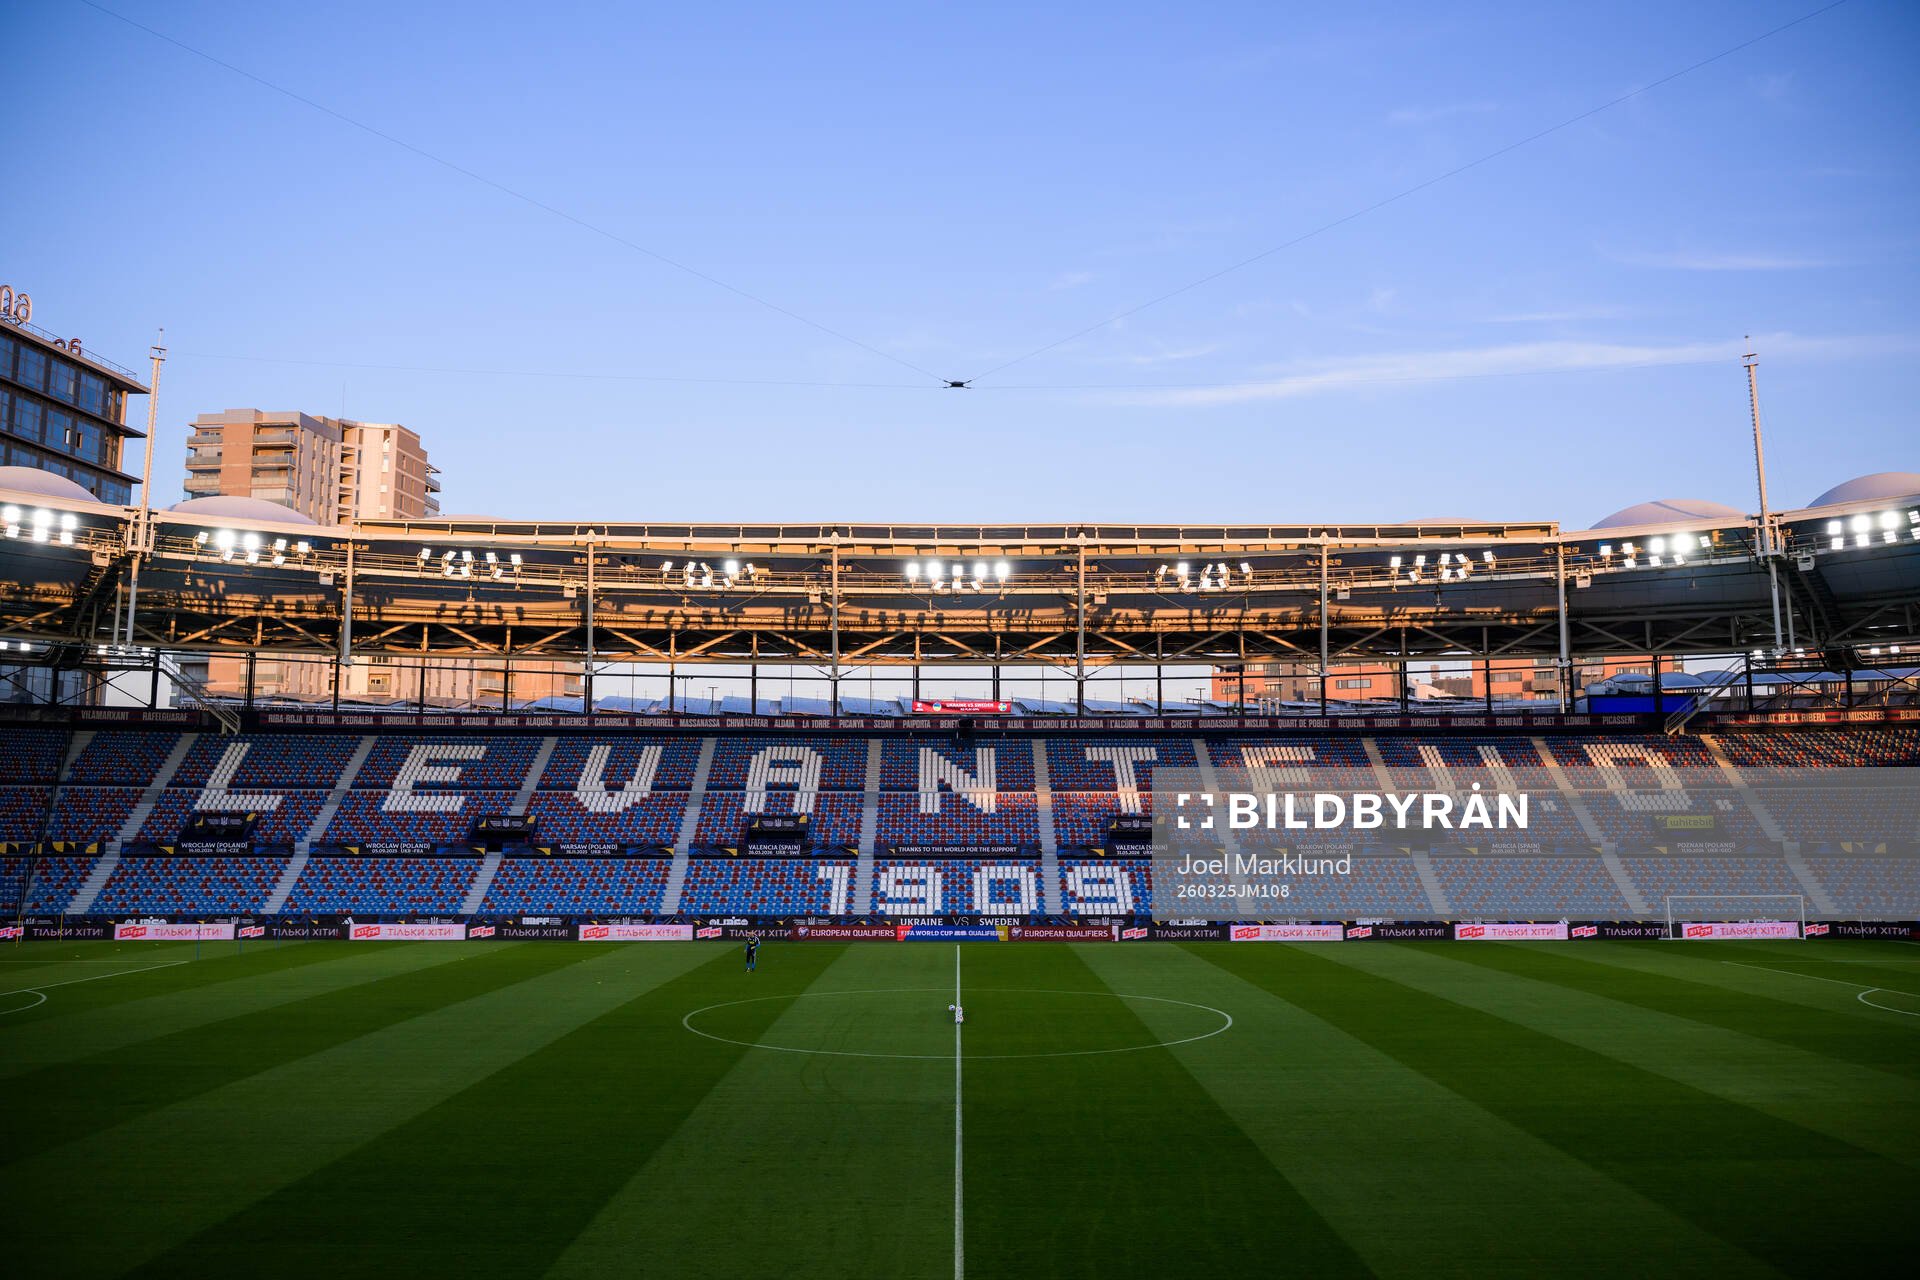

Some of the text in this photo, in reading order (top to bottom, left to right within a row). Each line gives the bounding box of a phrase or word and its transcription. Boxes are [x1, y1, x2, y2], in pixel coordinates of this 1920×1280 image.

[306, 715, 314, 724] DE
[342, 715, 374, 725] PEDRALBA
[494, 716, 519, 726] ALGINET
[1532, 716, 1555, 726] CARLET
[1602, 715, 1636, 725] PICASSENT
[1748, 712, 1827, 724] ALBALAT DE LA RIBERA
[1839, 711, 1886, 722] ALMUSSAFES
[594, 717, 629, 727] CATARROJA
[635, 717, 674, 727] BENIPARRELL
[679, 718, 720, 728] MASSANASSA
[726, 718, 744, 728] CHIVA
[802, 719, 831, 729] LA TORRE
[839, 719, 865, 729] PICANYA
[903, 719, 931, 729] PAIPORTA
[984, 719, 1000, 729] UTIEL
[1007, 719, 1025, 729] ALBAL
[1060, 719, 1069, 729] DE
[1070, 719, 1078, 729] LA
[1079, 719, 1104, 729] CORONA
[1170, 719, 1193, 728] CHESTE
[1244, 718, 1269, 728] MISLATA
[1277, 718, 1330, 729] QUART DE POBLET
[1338, 718, 1366, 729] REQUENA
[1373, 718, 1400, 728] TORRENT
[1410, 717, 1440, 727] XIRIVELLA
[1670, 816, 1713, 827] whitebit
[1517, 842, 1541, 850] (SPAIN)
[1677, 842, 1705, 850] POZNAN
[817, 864, 1133, 916] 1909
[900, 916, 1020, 926] UKRAINE VS SWEDEN
[810, 929, 896, 938] EUROPEAN QUALIFIERS
[1024, 930, 1109, 938] EUROPEAN QUALIFIERS
